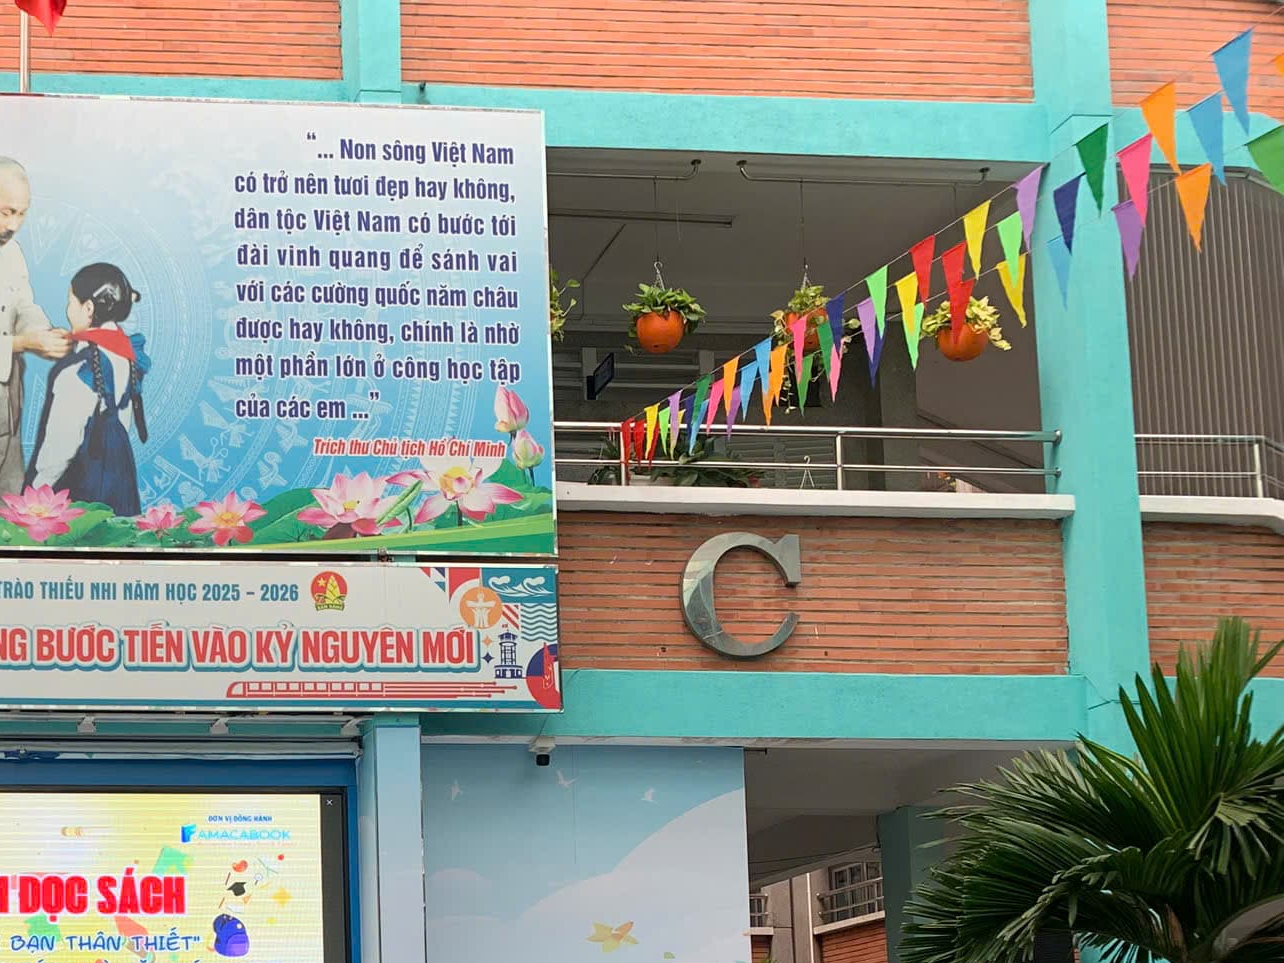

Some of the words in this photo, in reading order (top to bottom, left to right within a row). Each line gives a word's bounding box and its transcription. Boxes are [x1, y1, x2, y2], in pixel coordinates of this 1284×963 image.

[340, 138, 376, 160] Non
[382, 140, 426, 165] sông
[431, 141, 467, 168] Việt
[472, 143, 514, 165] Nam
[234, 175, 257, 193] có
[262, 170, 289, 194] trở
[294, 173, 328, 195] nên
[334, 175, 369, 196] tươi
[375, 175, 409, 202] đẹp
[415, 176, 447, 201] hay
[453, 178, 515, 203] không,
[235, 392, 270, 418] của
[276, 395, 311, 418] các
[316, 400, 346, 419] em
[314, 438, 346, 455] Trích
[349, 440, 370, 455] thư
[373, 438, 397, 456] Chủ
[401, 440, 425, 459] tịch
[429, 438, 446, 456] Hồ
[449, 439, 469, 457] Chí
[474, 441, 505, 457] Minh
[39, 575, 84, 600] THIẾU
[90, 582, 117, 601] NHI
[123, 580, 160, 601] NĂM
[165, 582, 197, 602] HỌC
[202, 583, 241, 602] 2025
[260, 583, 299, 602] 2026
[682, 531, 801, 659] C
[36, 622, 115, 663] BƯỚC
[123, 622, 183, 663] TIẾN
[192, 626, 247, 663] VÀO
[255, 622, 293, 663] KỶ
[302, 625, 414, 664] NGUYÊN
[422, 624, 474, 664] MỚI
[17, 874, 89, 923] ĐỌC
[96, 866, 186, 915] SÁCH
[12, 936, 54, 953] BẠN
[66, 932, 121, 951] THÂN
